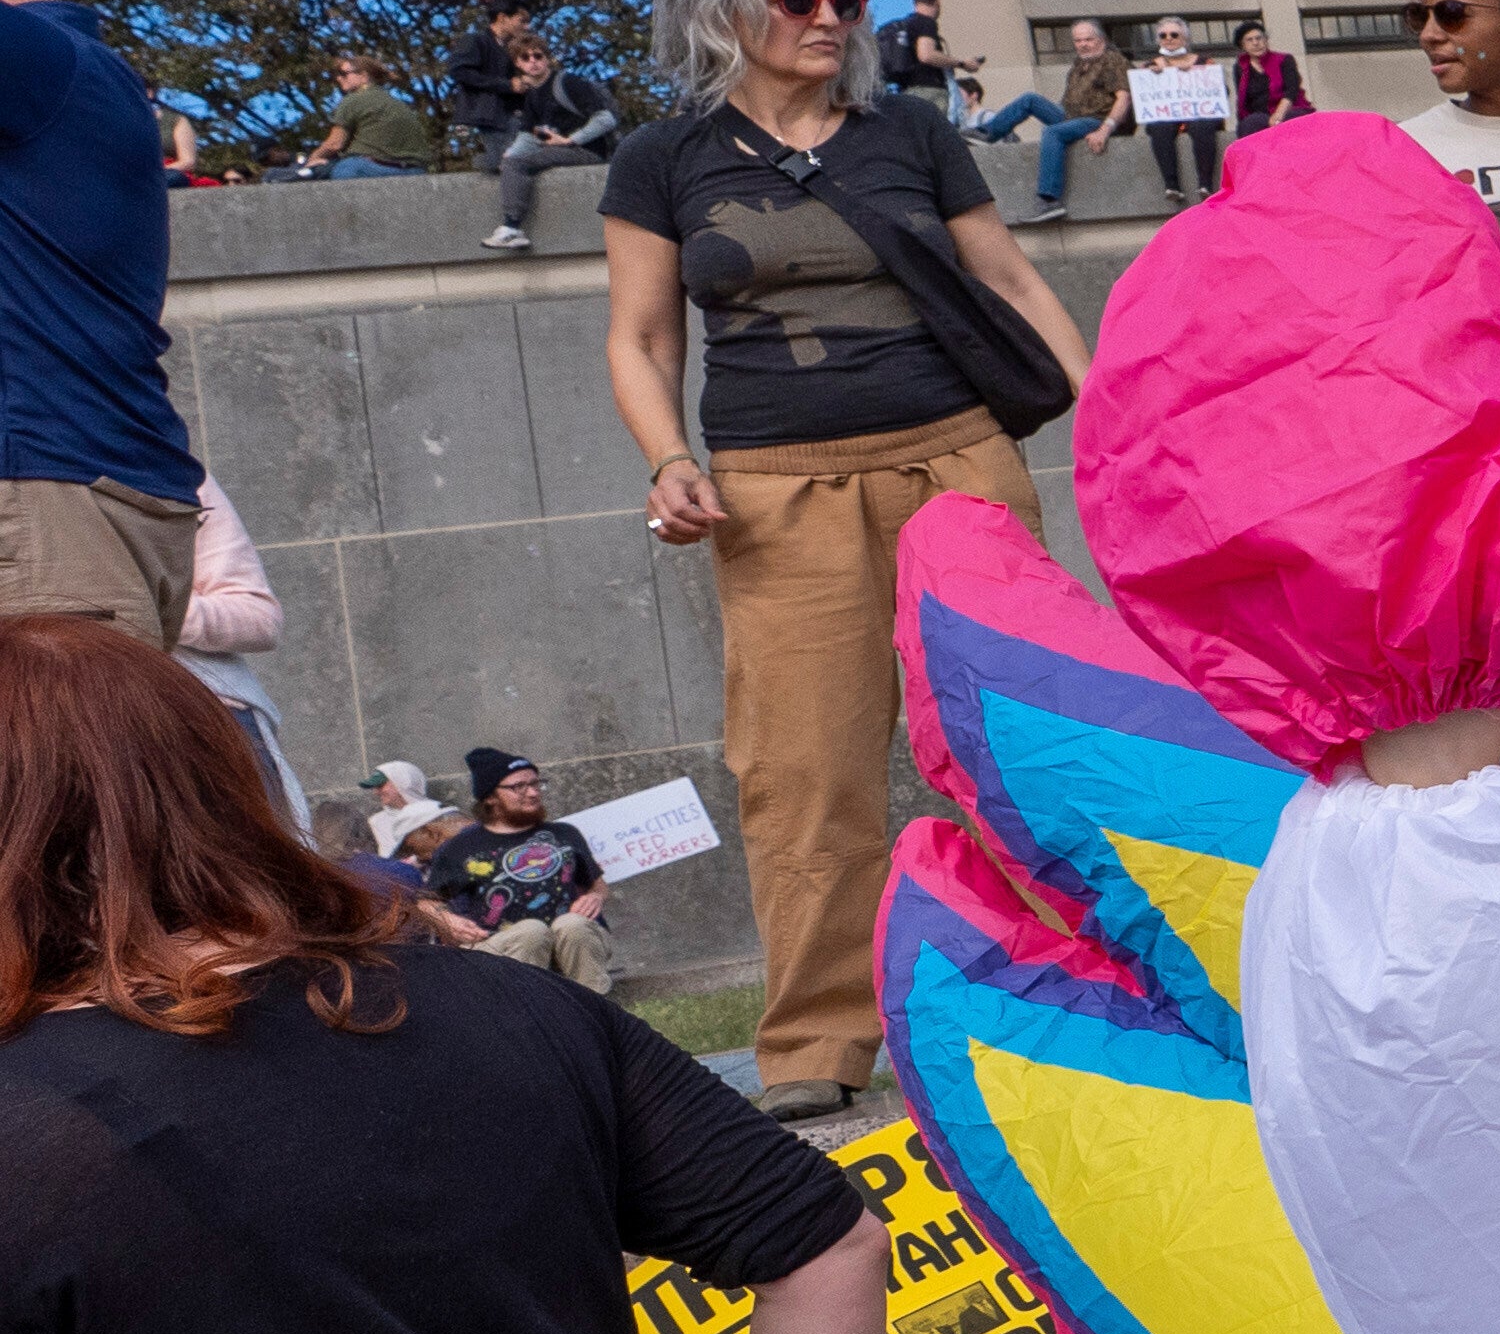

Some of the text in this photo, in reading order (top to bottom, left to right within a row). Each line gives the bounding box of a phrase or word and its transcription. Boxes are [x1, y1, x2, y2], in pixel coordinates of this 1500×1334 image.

[1141, 100, 1226, 120] AMERICA
[644, 802, 700, 834] CITIES
[624, 832, 667, 857] FED
